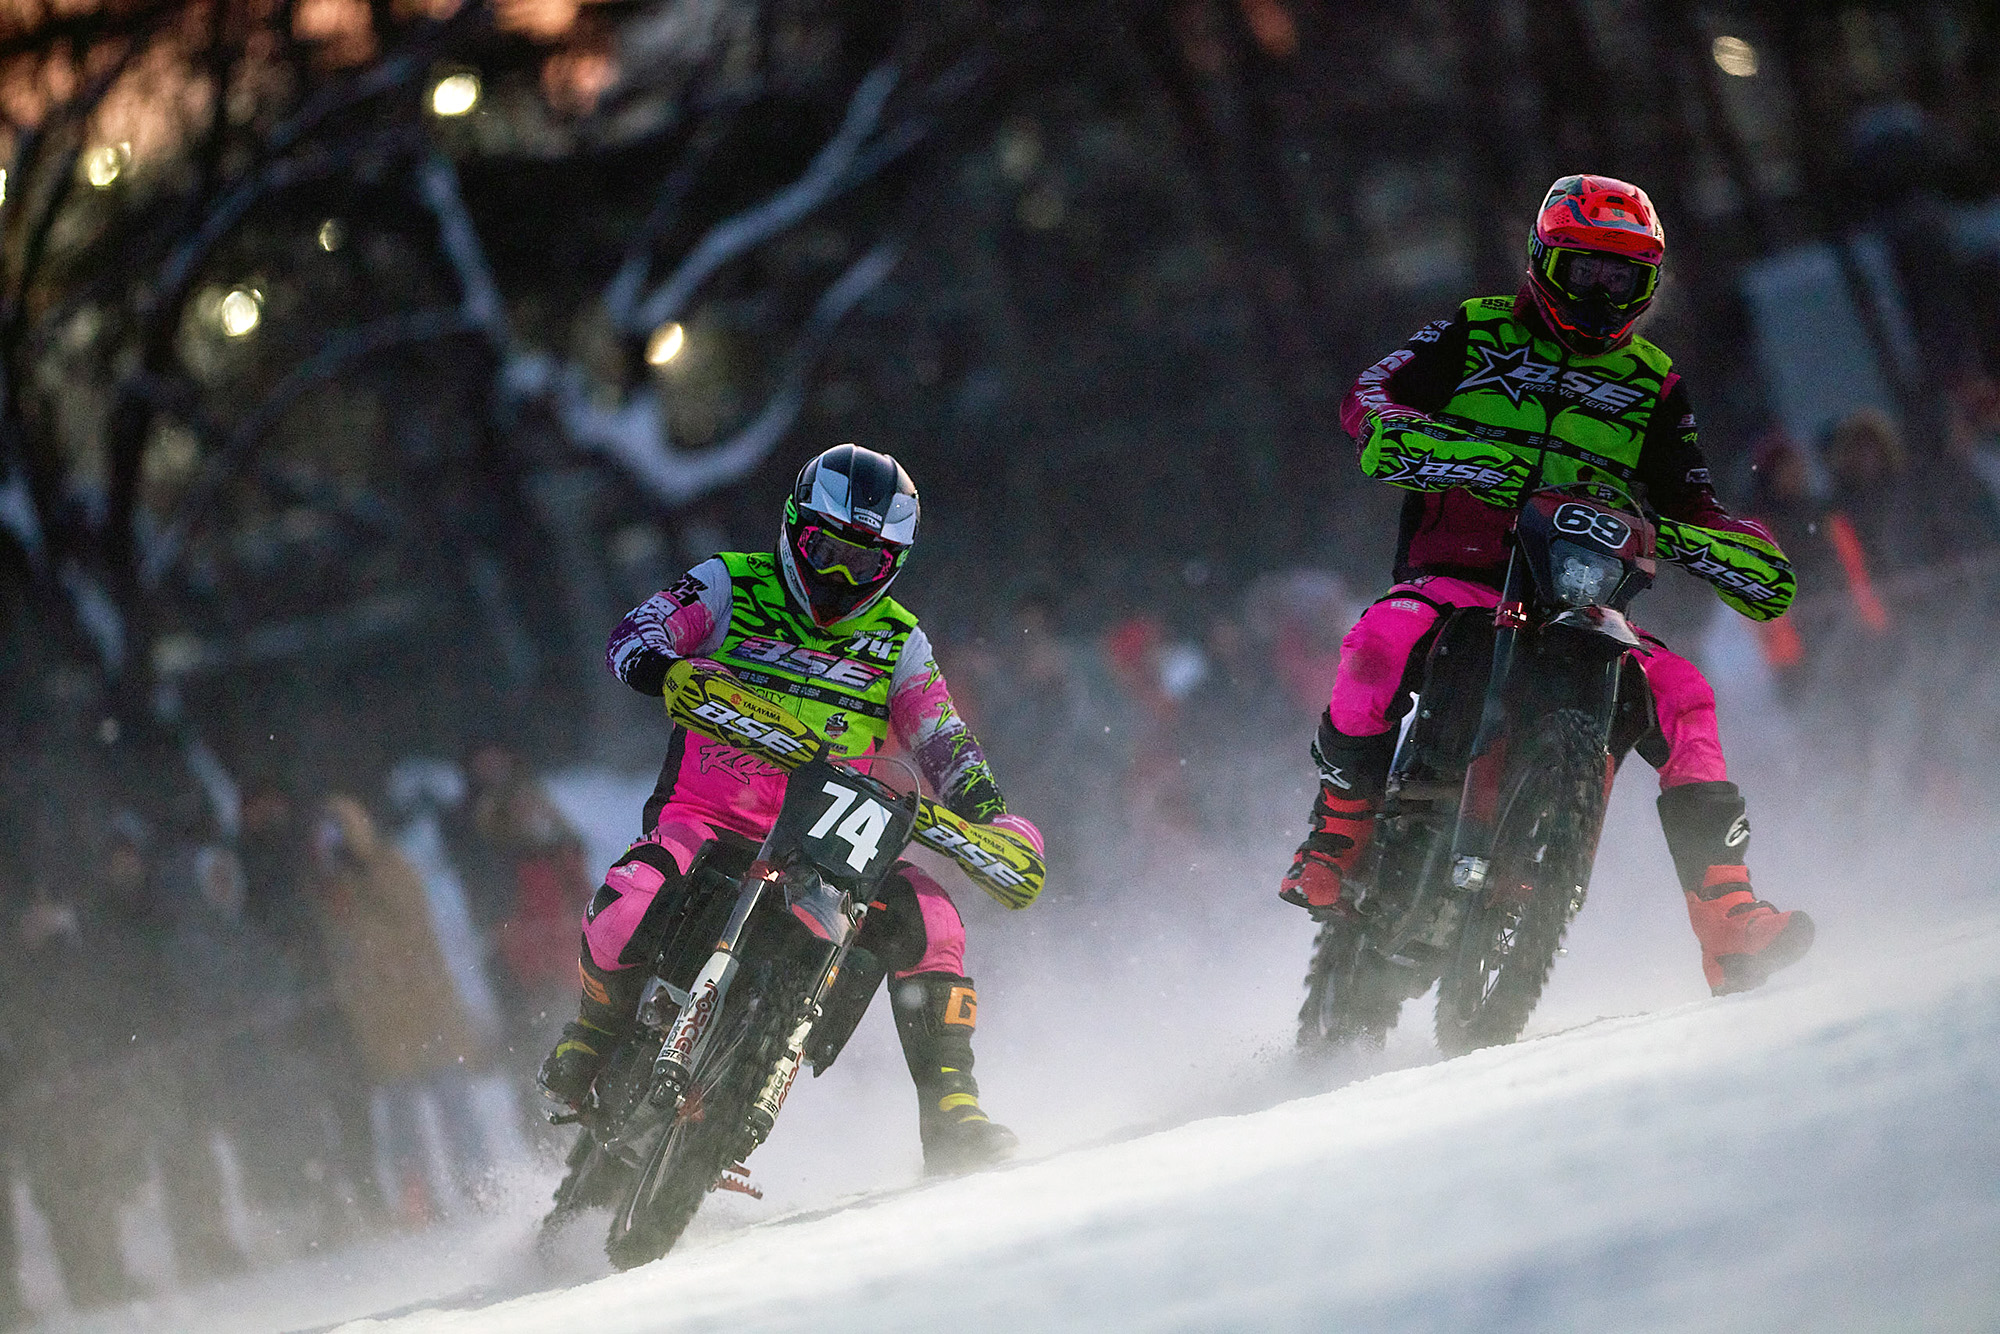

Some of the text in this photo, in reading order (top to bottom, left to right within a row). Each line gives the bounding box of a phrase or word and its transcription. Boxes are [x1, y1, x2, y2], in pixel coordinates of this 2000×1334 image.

[1504, 361, 1645, 409] BSE
[1519, 382, 1621, 414] RACING TEAM
[1415, 462, 1509, 485] BSE
[1553, 502, 1632, 549] 69
[1687, 559, 1778, 601] BSE
[730, 635, 887, 690] BSE
[849, 636, 894, 660] 74
[690, 700, 804, 755] BSE
[743, 701, 781, 721] TAKAYAMA
[807, 780, 893, 874] 74
[919, 824, 1027, 888] BSE
